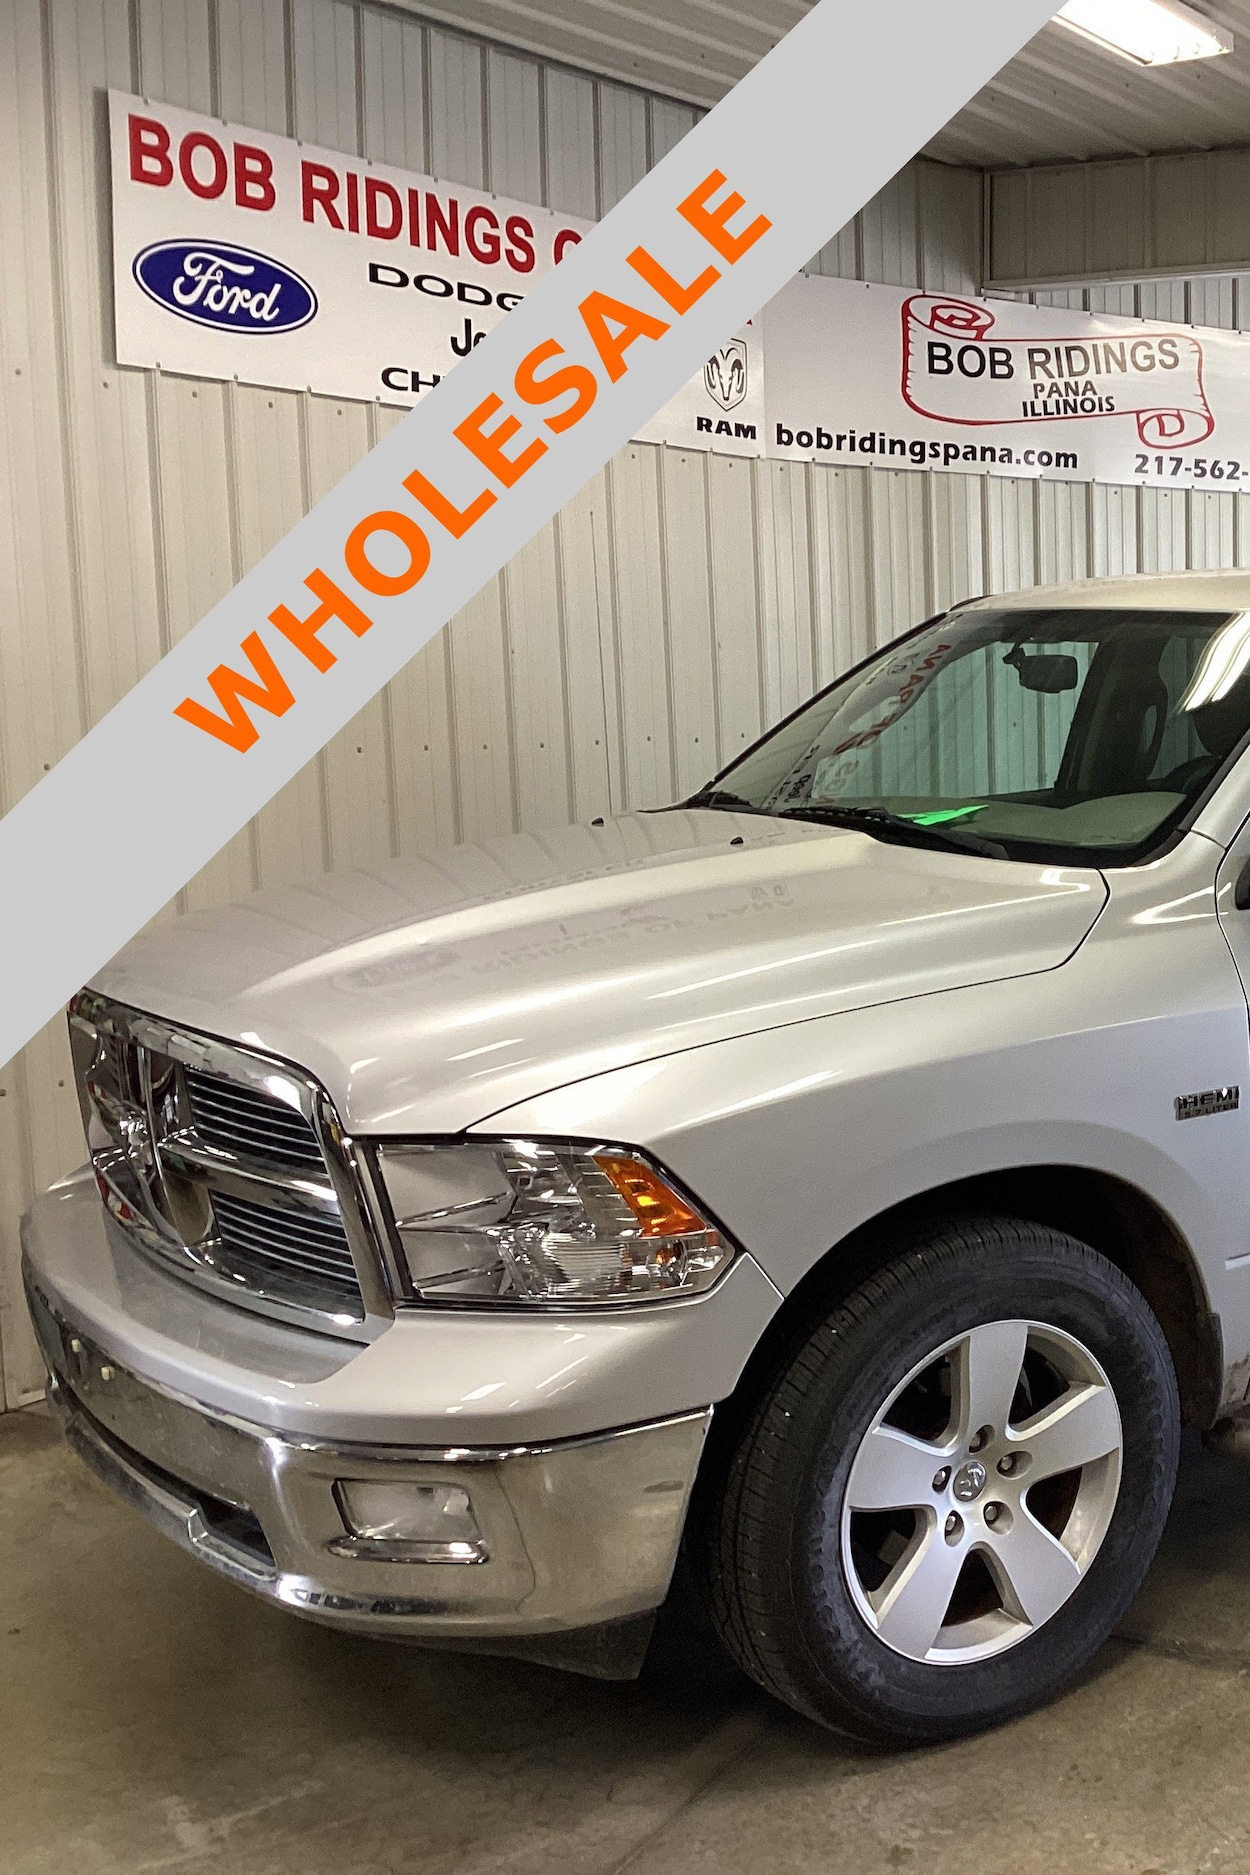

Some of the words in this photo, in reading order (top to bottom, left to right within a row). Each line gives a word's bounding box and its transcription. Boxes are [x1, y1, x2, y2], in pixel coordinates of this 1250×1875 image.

[128, 113, 276, 212] BOB
[301, 159, 536, 274] RIDINGS
[172, 251, 282, 321] Ford
[368, 262, 525, 311] DODG
[927, 341, 1014, 380] BOB
[1027, 338, 1180, 380] RIDINGS
[1022, 395, 1115, 418] ILLINOIS
[1033, 380, 1098, 399] PANA
[696, 416, 757, 440] RAM
[776, 423, 1078, 470] bobridingspana.com
[1174, 1085, 1239, 1109] HEMI
